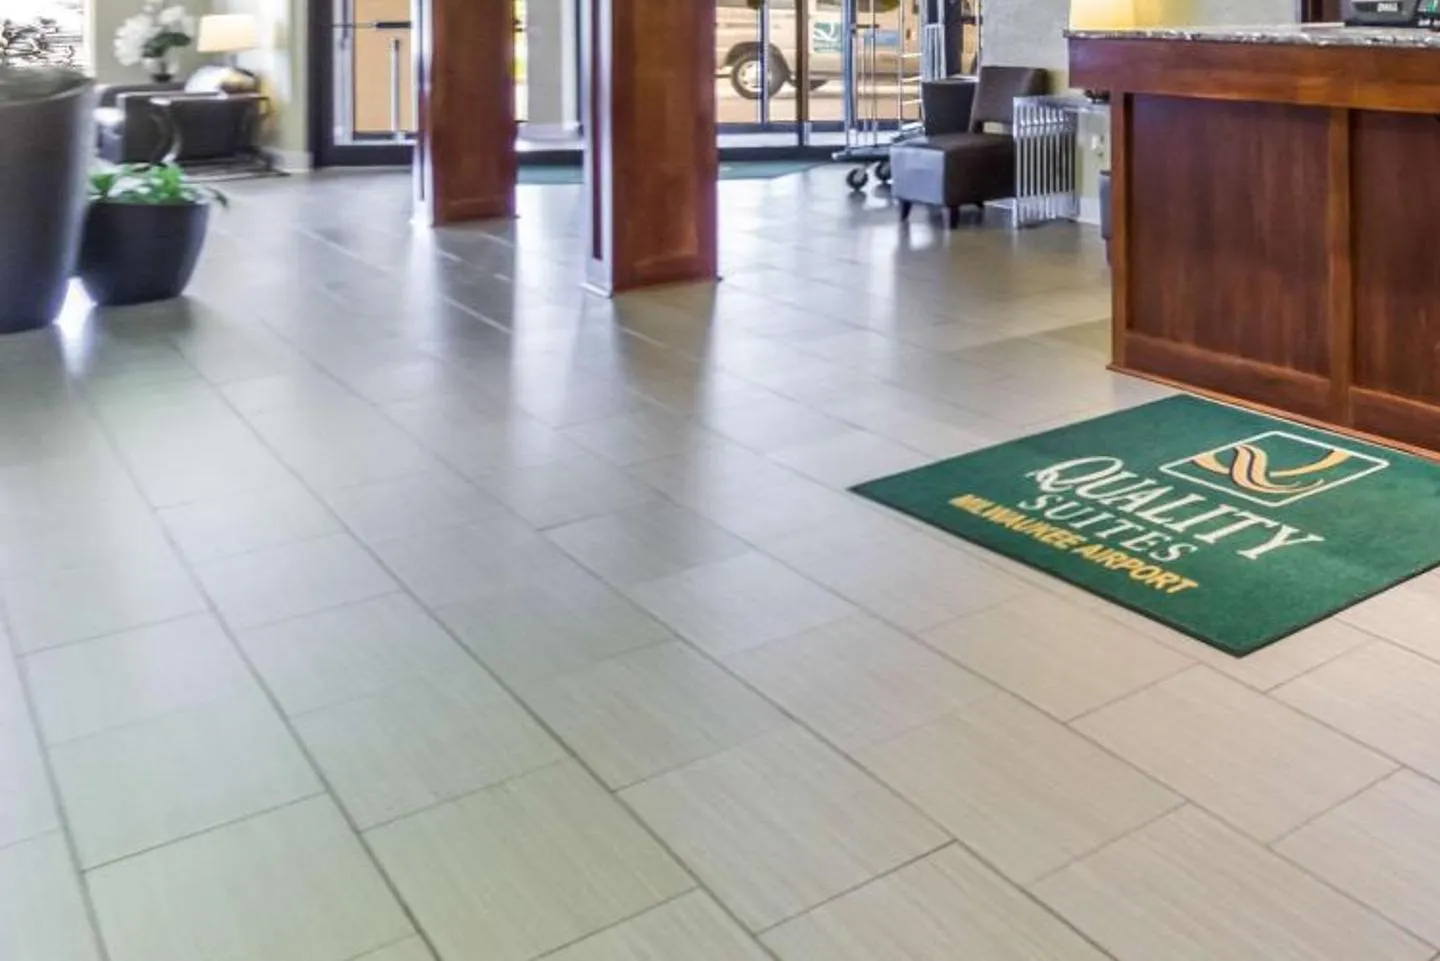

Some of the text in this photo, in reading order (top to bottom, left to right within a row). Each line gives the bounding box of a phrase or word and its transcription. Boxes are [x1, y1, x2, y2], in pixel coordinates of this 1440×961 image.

[949, 494, 1199, 594] MILWAUKEE AIRPORT
[1018, 494, 1198, 563] SUITES
[1024, 455, 1324, 560] QUALITY
